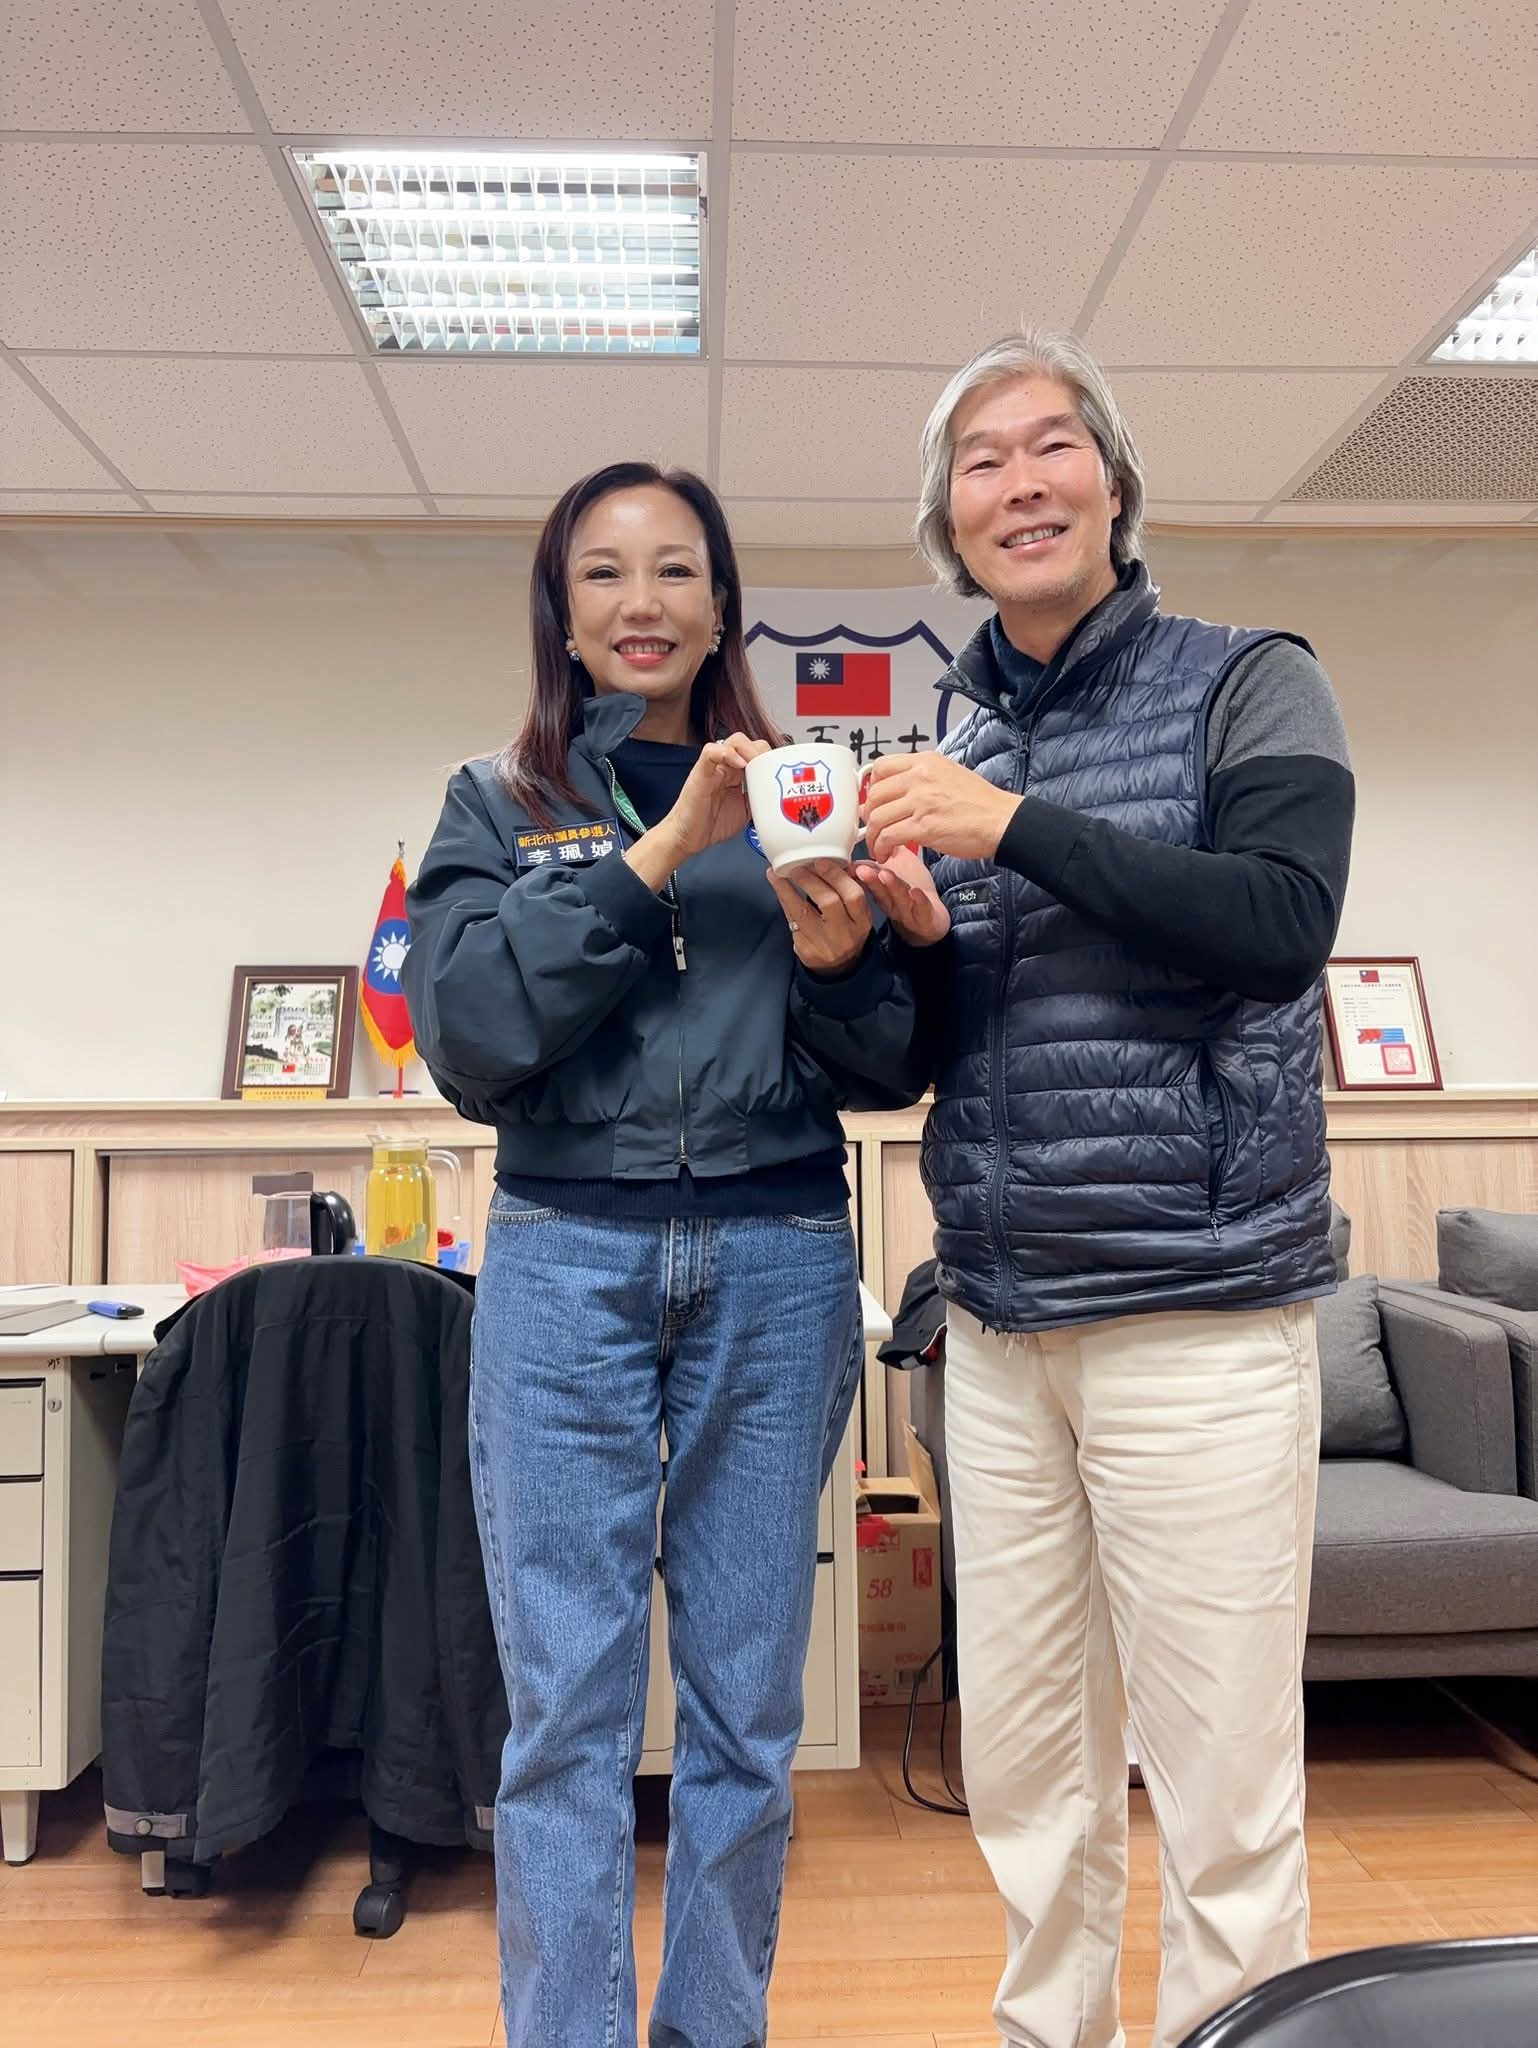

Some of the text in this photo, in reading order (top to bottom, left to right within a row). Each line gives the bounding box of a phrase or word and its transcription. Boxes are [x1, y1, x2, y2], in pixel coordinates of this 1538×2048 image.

[517, 823, 616, 849] 新北市議員參選人
[866, 1577, 894, 1600] 58
